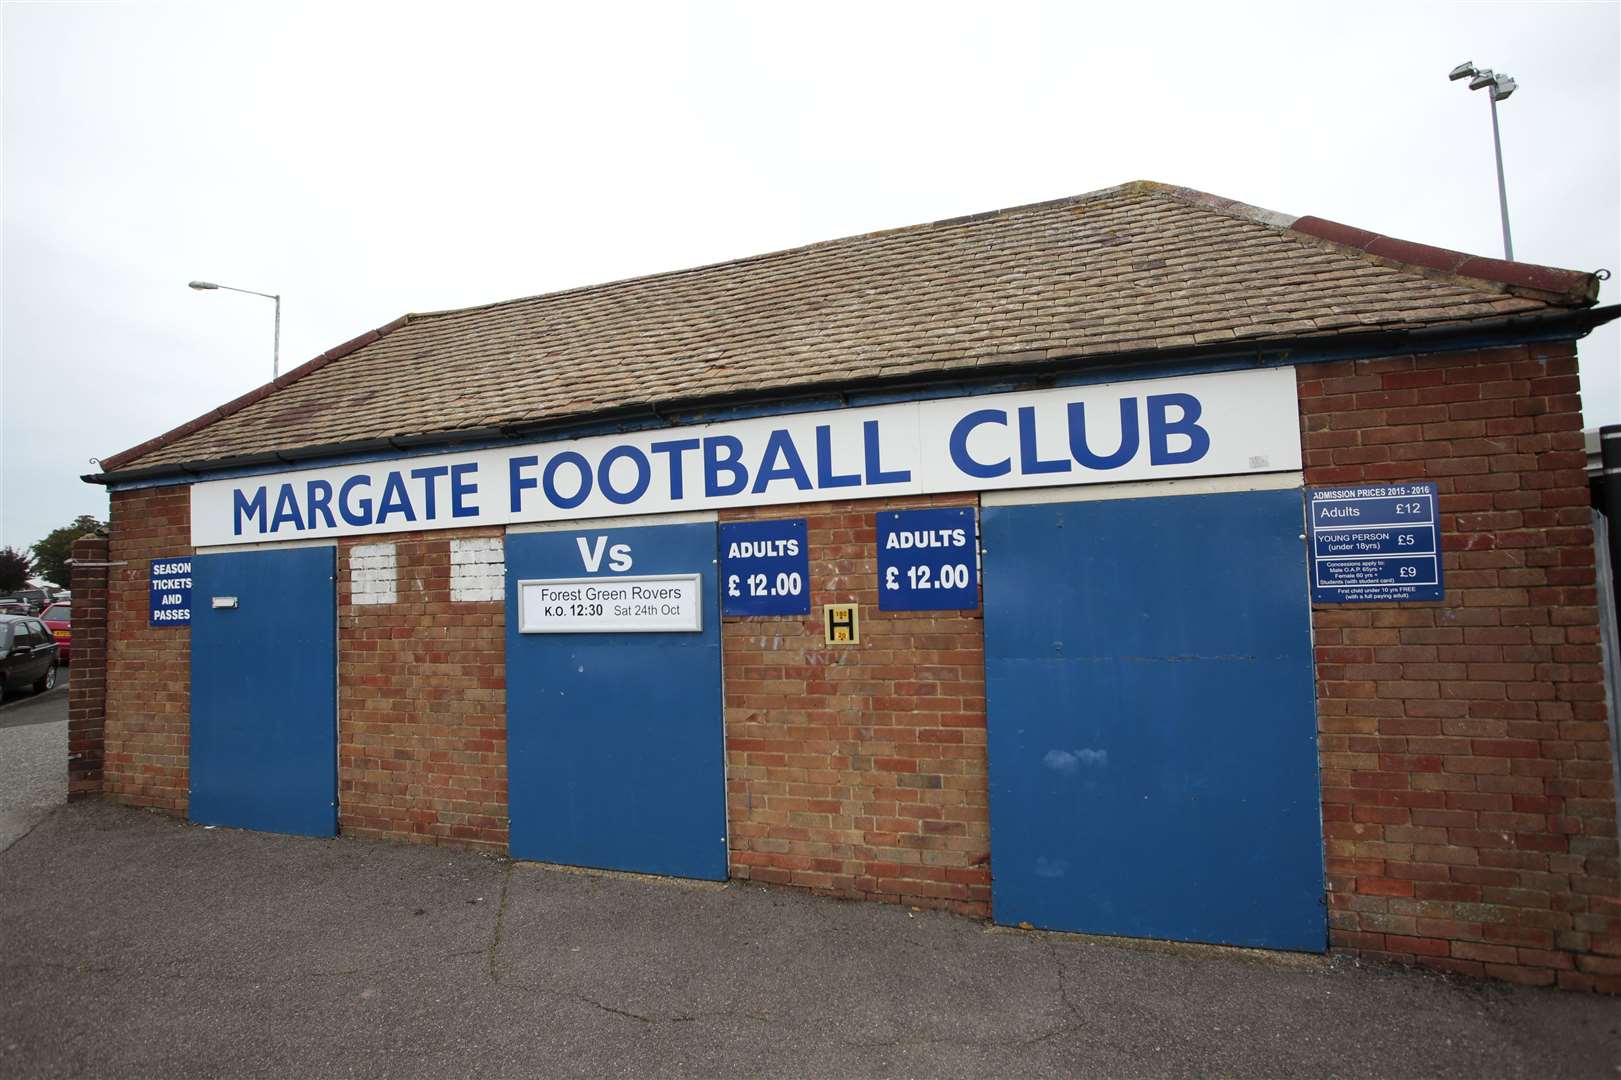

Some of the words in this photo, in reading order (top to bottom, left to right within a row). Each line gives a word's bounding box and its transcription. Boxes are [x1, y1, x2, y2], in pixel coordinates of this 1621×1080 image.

[234, 462, 480, 535] MARGATE
[509, 420, 911, 513] FOOTBALL
[949, 392, 1210, 478] CLUB
[1313, 490, 1355, 499] ADMISSION
[1357, 488, 1385, 497] PRICES
[1387, 487, 1405, 496] 2015
[1411, 486, 1430, 495] 2016
[1320, 507, 1360, 518] Adults
[1396, 503, 1421, 514] £12
[886, 529, 966, 549] ADULTS
[1318, 534, 1350, 542] YOUNG
[1352, 533, 1389, 541] PERSON
[1398, 535, 1415, 545] £5
[576, 536, 632, 572] Vs
[728, 539, 799, 558] ADULTS
[1328, 543, 1354, 552] (under
[1356, 542, 1381, 550] 18yrs)
[153, 563, 192, 575] SEASON
[1400, 567, 1416, 577] £9
[152, 578, 192, 590] TICKETS
[886, 567, 899, 590] £
[907, 564, 969, 589] 12.00
[728, 575, 740, 597] £
[747, 572, 802, 596] 12.00
[162, 594, 182, 605] AND
[541, 588, 582, 601] Forest
[585, 587, 627, 601] Green
[631, 586, 682, 600] Rovers
[153, 609, 190, 621] PASSES
[544, 606, 567, 617] K.O.
[569, 604, 603, 616] 12:30
[614, 605, 631, 616] Sat
[634, 604, 657, 615] 24th
[661, 604, 680, 615] Oct
[829, 608, 854, 640] H
